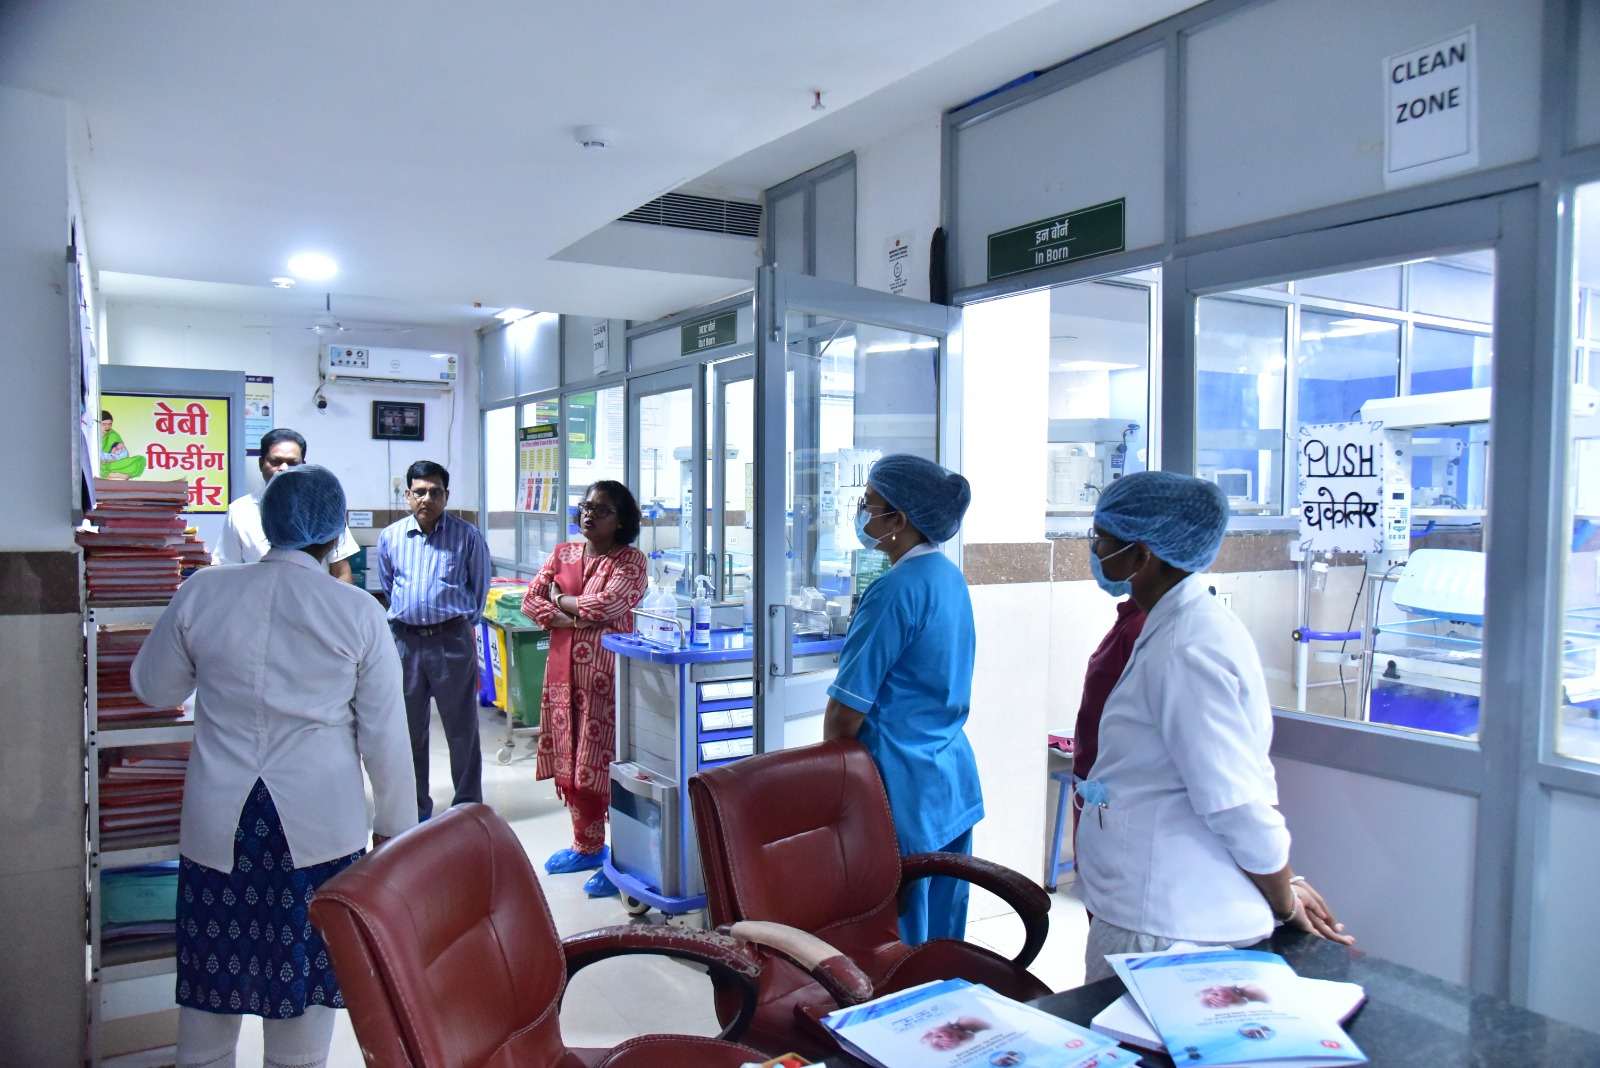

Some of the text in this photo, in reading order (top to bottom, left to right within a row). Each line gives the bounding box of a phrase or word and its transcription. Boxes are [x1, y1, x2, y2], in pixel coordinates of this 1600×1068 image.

[1392, 43, 1466, 84] CLEAN
[1396, 86, 1460, 124] ZONE
[1035, 219, 1069, 245] इन बोर्न
[1035, 246, 1069, 265] In Born
[154, 402, 208, 435] बेबी
[146, 443, 224, 471] फिडींग
[1304, 440, 1374, 476] PUSH
